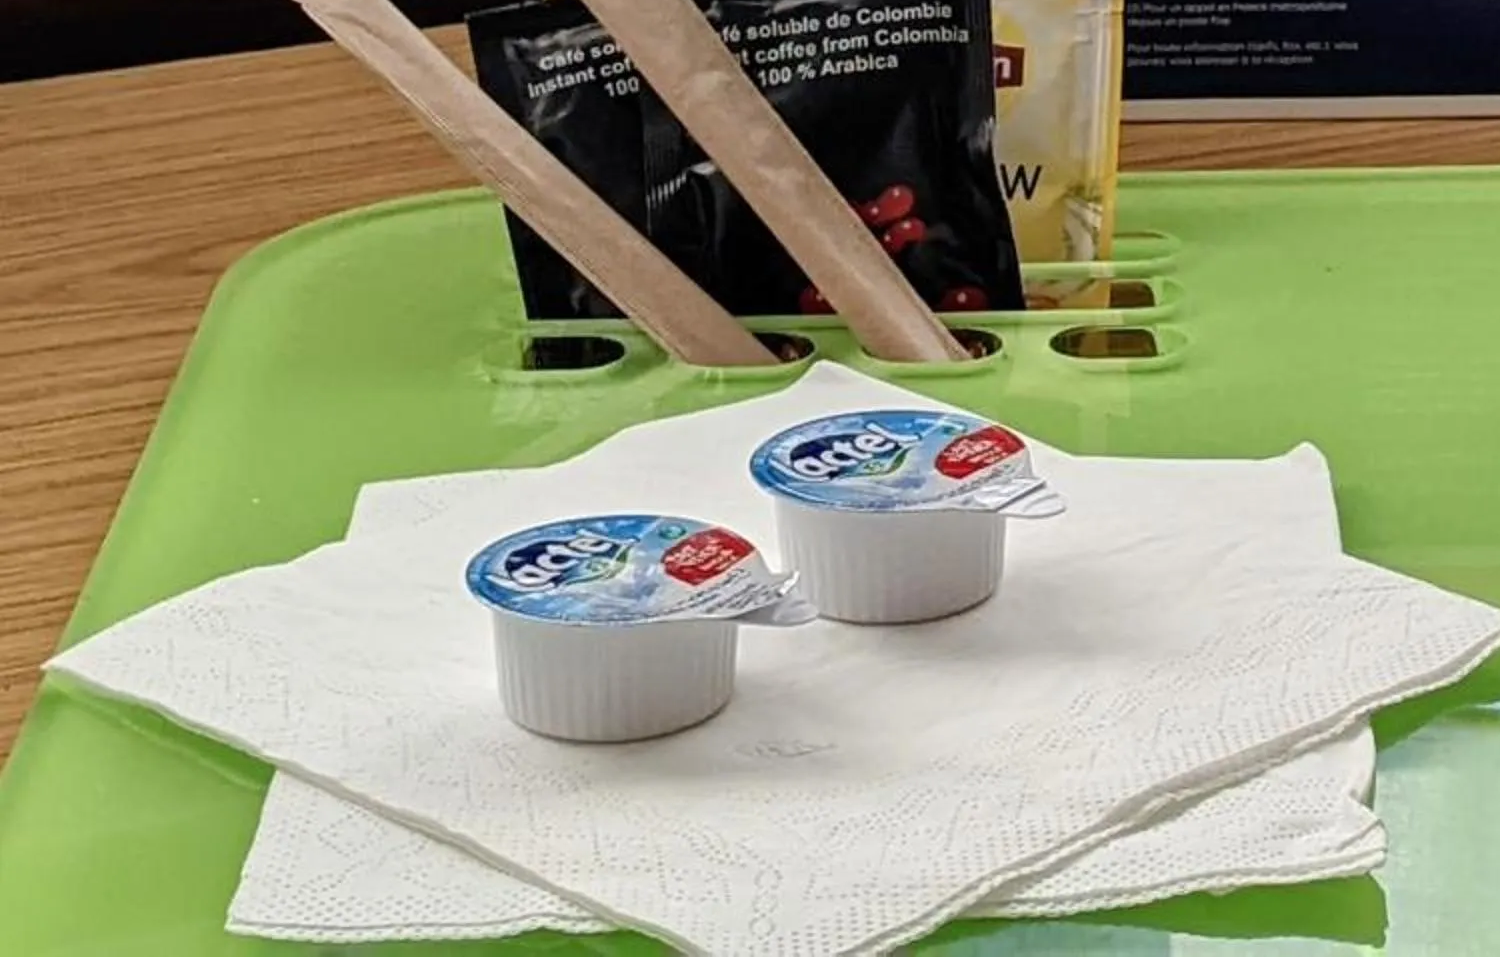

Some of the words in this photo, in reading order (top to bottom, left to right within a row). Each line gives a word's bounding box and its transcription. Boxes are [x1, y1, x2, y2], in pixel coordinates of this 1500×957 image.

[722, 24, 741, 44] fé
[746, 16, 821, 40] soluble
[826, 11, 851, 30] de
[856, 2, 953, 26] Colombie
[537, 49, 585, 71] Café
[755, 43, 818, 65] coffee
[822, 36, 869, 55] from
[874, 24, 970, 47] Colombia
[526, 66, 597, 100] Instant
[604, 76, 640, 98] 100
[756, 66, 792, 88] 100
[797, 62, 817, 81] %
[820, 53, 899, 77] Arabica
